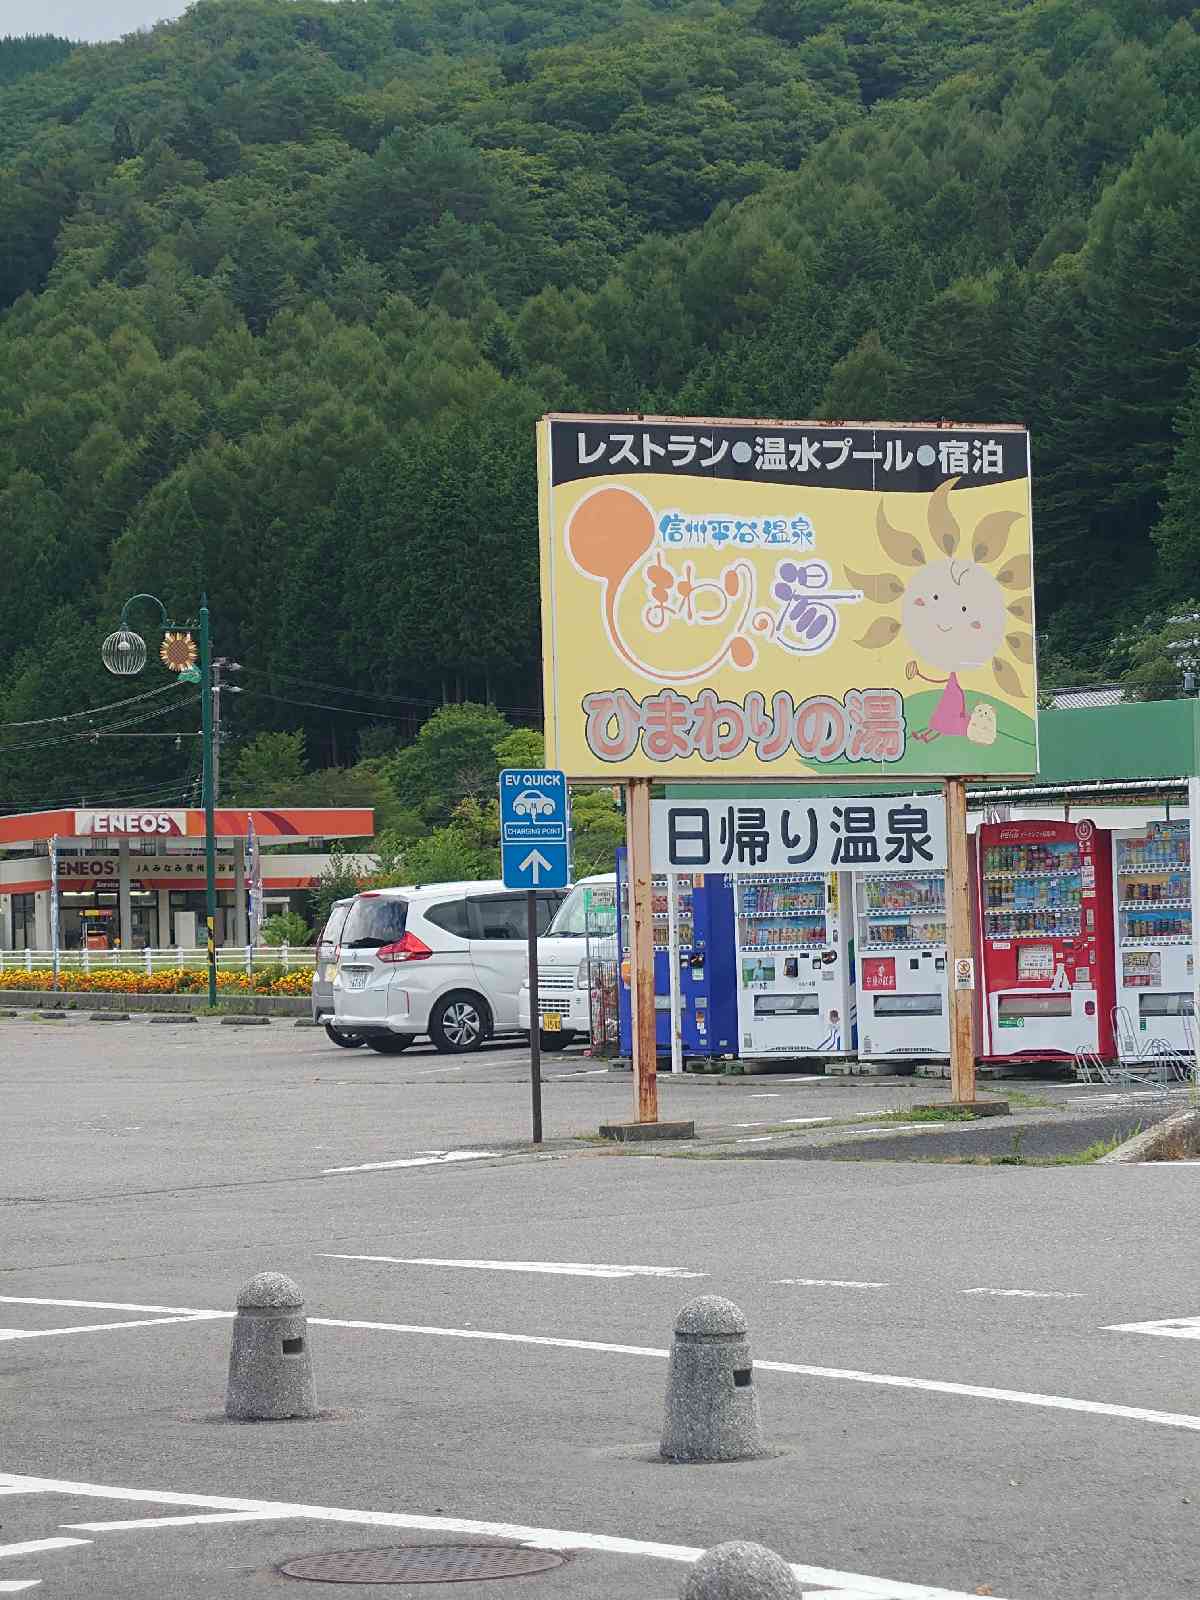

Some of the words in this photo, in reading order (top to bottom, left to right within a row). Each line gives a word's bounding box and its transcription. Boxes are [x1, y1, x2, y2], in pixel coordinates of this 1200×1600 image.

[658, 512, 814, 545] 信州平谷温泉
[583, 688, 906, 762] ひまわりの湯
[505, 774, 520, 786] EV
[523, 774, 561, 786] QUICK
[94, 813, 172, 833] ENEOS
[667, 803, 934, 866] 日帰り温泉
[57, 860, 115, 876] ENEOS
